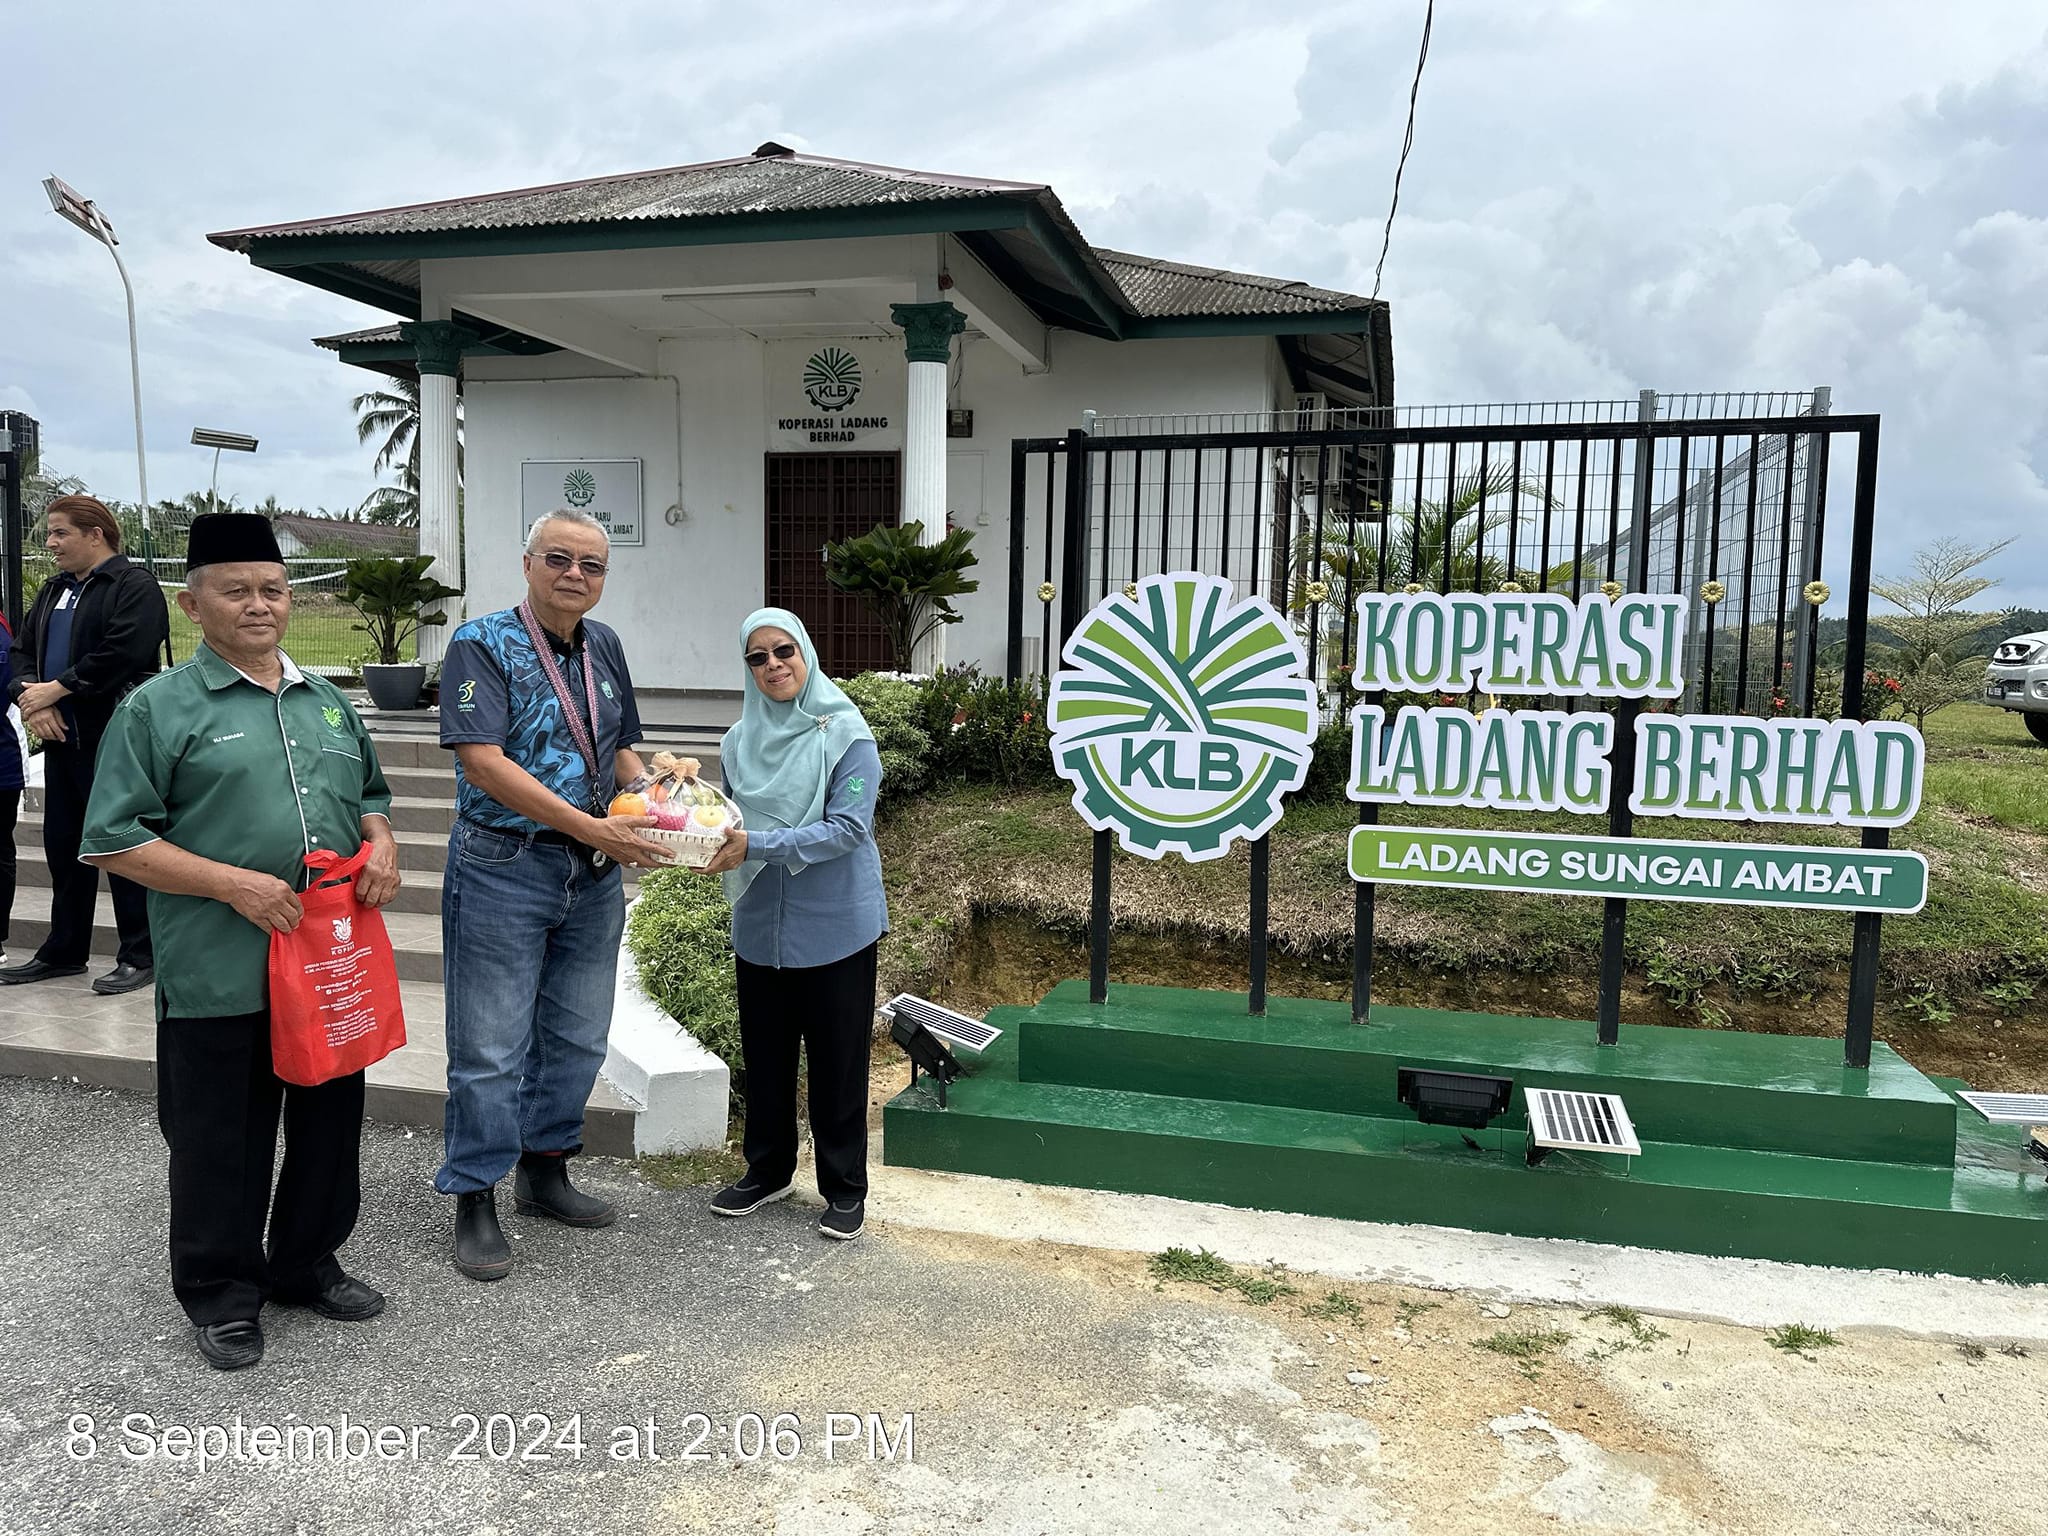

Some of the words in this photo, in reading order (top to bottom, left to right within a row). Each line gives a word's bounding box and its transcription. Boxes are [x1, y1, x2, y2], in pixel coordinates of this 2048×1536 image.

[818, 385, 848, 398] KLB
[778, 418, 834, 430] KOPERASI
[840, 417, 888, 429] LADANG
[809, 431, 855, 442] BERHAD
[571, 491, 588, 499] KLB
[613, 524, 634, 535] AMBAT
[1361, 601, 1681, 690] KOPERASI
[1120, 738, 1243, 792] KLB
[1357, 713, 1606, 805] LADANG
[1639, 721, 1916, 819] BERHAD
[1378, 841, 1551, 879] LADANG
[1560, 850, 1722, 889] SUNGAI
[1732, 860, 1893, 897] AMBAT
